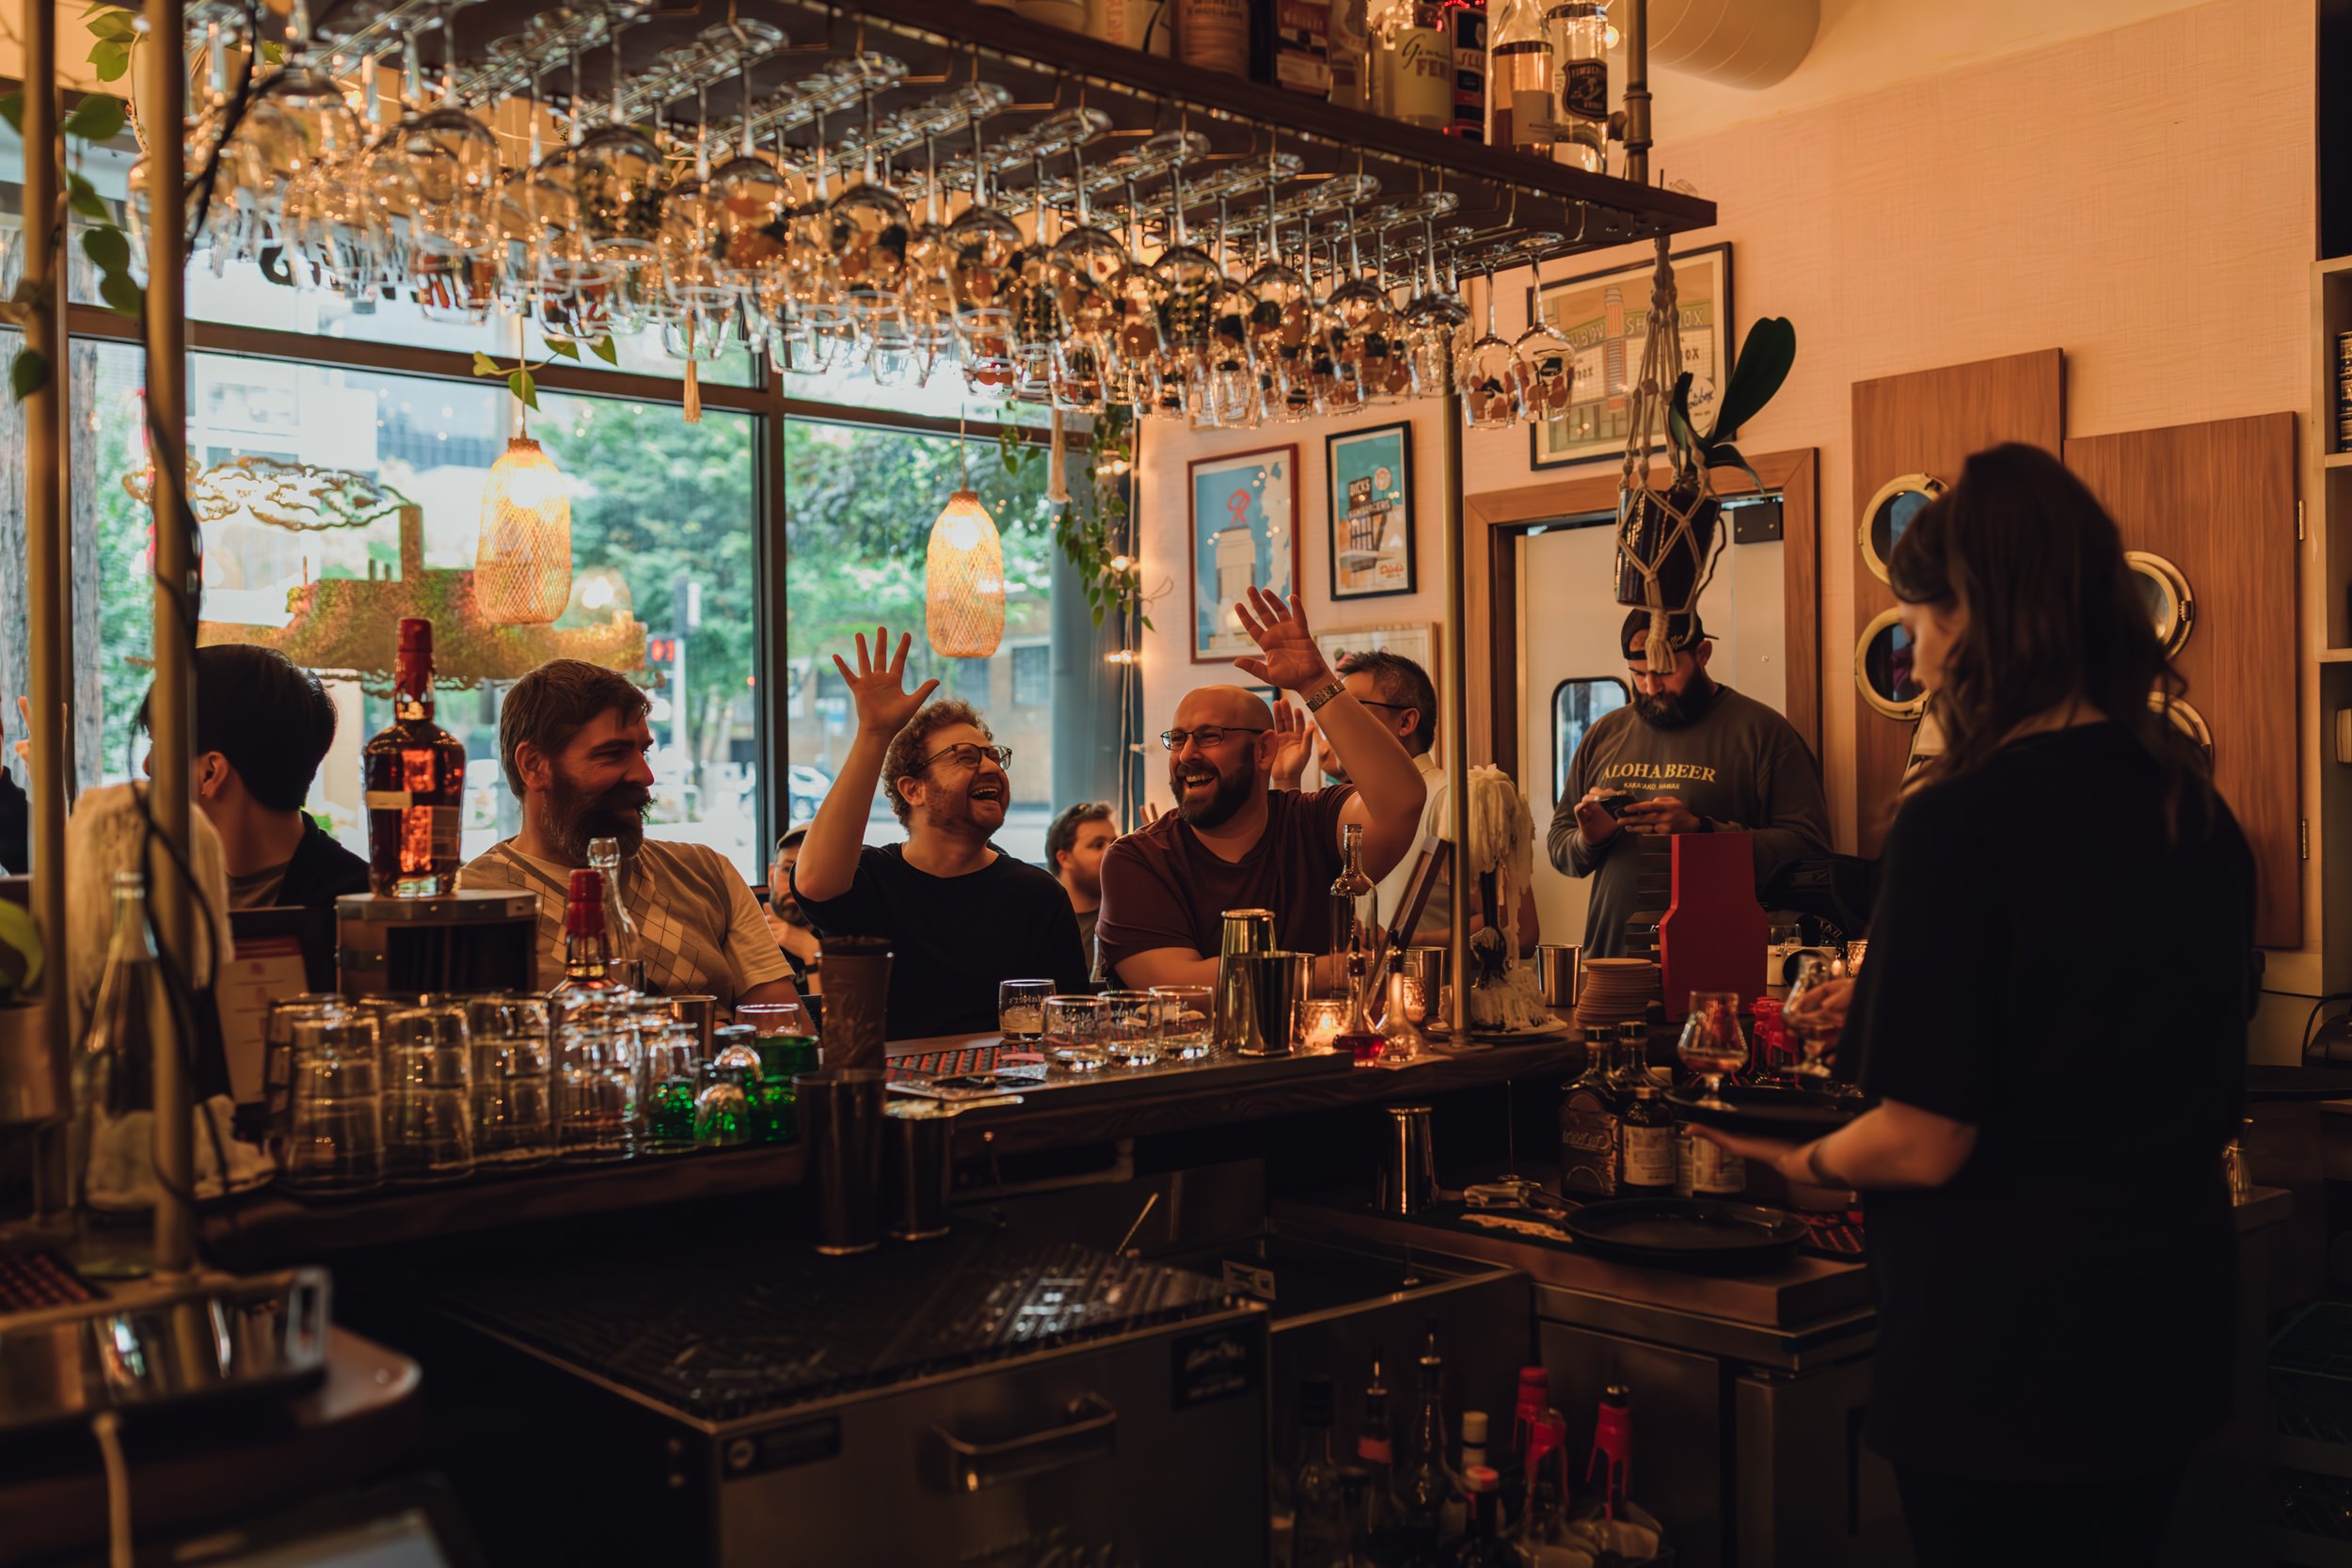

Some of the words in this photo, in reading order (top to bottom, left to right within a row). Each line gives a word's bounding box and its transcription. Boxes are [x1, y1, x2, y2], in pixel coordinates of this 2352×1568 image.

[1626, 310, 1702, 335] SHOX
[1604, 763, 1661, 780] ALOHA
[1664, 763, 1716, 784] BEER
